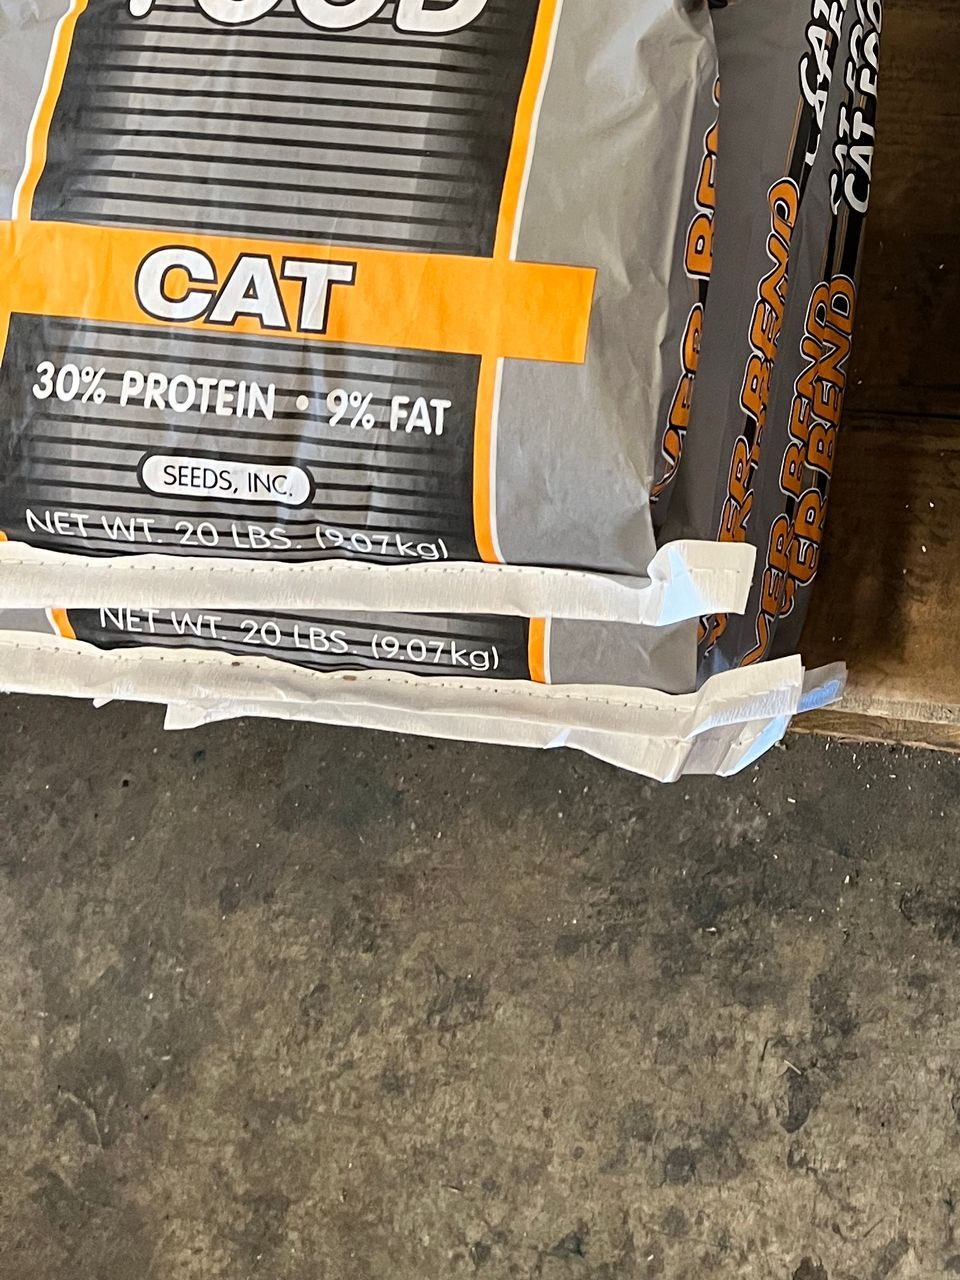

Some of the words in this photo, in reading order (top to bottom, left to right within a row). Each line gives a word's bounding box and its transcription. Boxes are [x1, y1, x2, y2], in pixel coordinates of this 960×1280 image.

[844, 108, 876, 215] CAT
[134, 245, 357, 334] CAT
[31, 361, 107, 404] 30%
[120, 370, 276, 420] PROTEIN
[325, 389, 375, 430] 9%
[389, 396, 451, 435] FAT
[805, 275, 857, 474] BEND
[162, 464, 239, 494] SEEDS,
[246, 470, 294, 498] INC.
[25, 507, 89, 538] NET
[101, 515, 164, 544] WT.
[175, 521, 219, 547] 20
[231, 526, 303, 550] LBS.
[100, 607, 160, 635] NET
[171, 612, 229, 641] WT.
[239, 620, 280, 647] 20
[293, 627, 359, 655] LBS.
[371, 633, 500, 671] (9.07kg)
